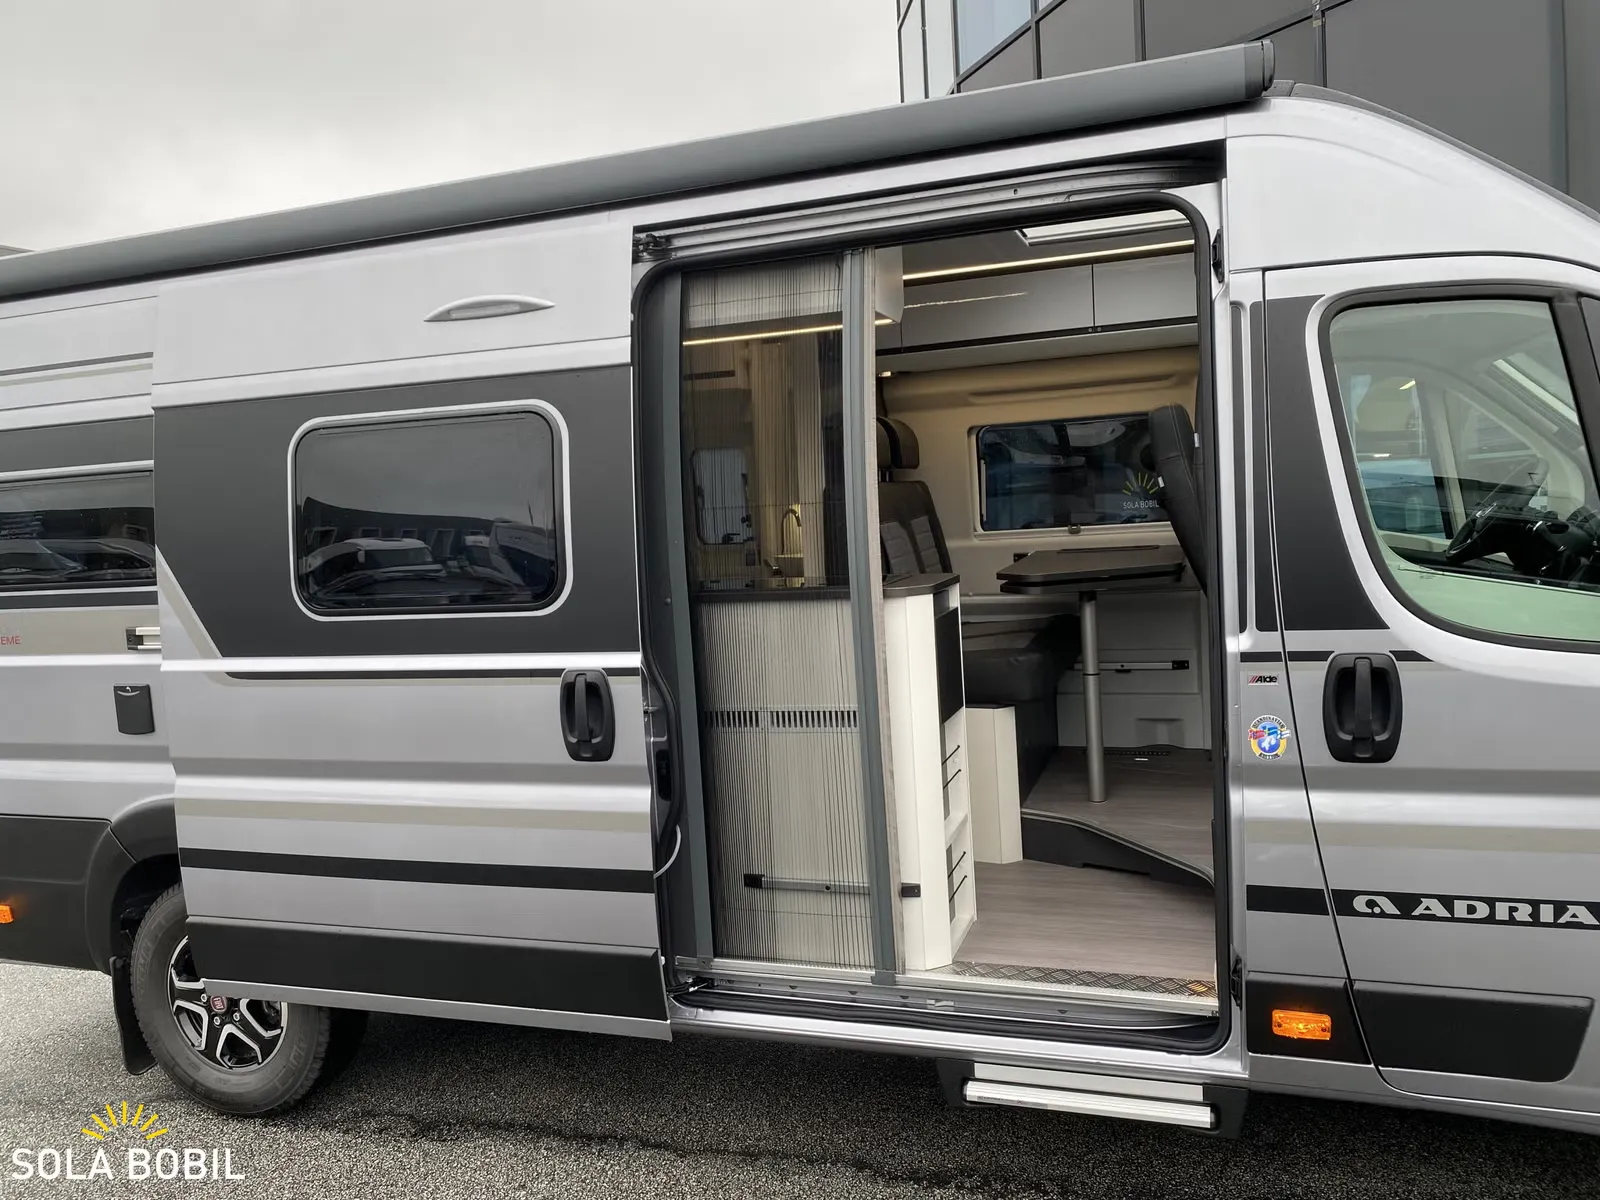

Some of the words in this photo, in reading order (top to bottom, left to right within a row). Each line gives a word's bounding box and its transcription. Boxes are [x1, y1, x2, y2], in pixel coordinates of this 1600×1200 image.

[1123, 501, 1139, 509] SOLA
[1140, 500, 1159, 508] BOBIL
[1255, 675, 1278, 684] Alde
[1411, 897, 1600, 925] ADRIA
